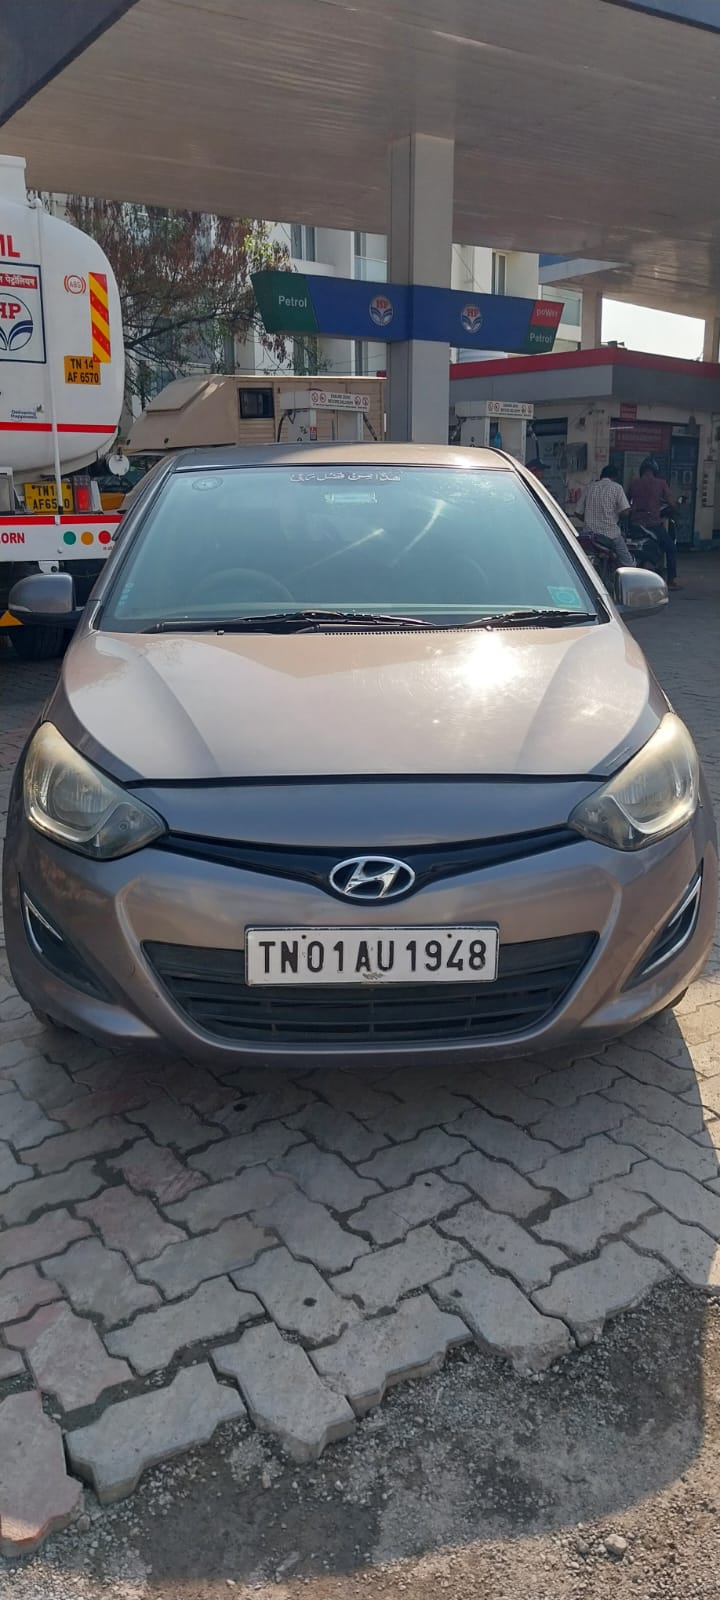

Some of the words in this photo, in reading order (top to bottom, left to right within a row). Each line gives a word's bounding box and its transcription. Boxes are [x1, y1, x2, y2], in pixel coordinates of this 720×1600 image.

[278, 294, 307, 308] Petrol
[529, 332, 552, 344] Petrol
[70, 358, 82, 369] TN
[84, 359, 93, 370] 14
[67, 372, 78, 382] AF
[80, 372, 99, 384] 6570
[33, 498, 70, 510] AF650
[0, 532, 25, 544] ORN
